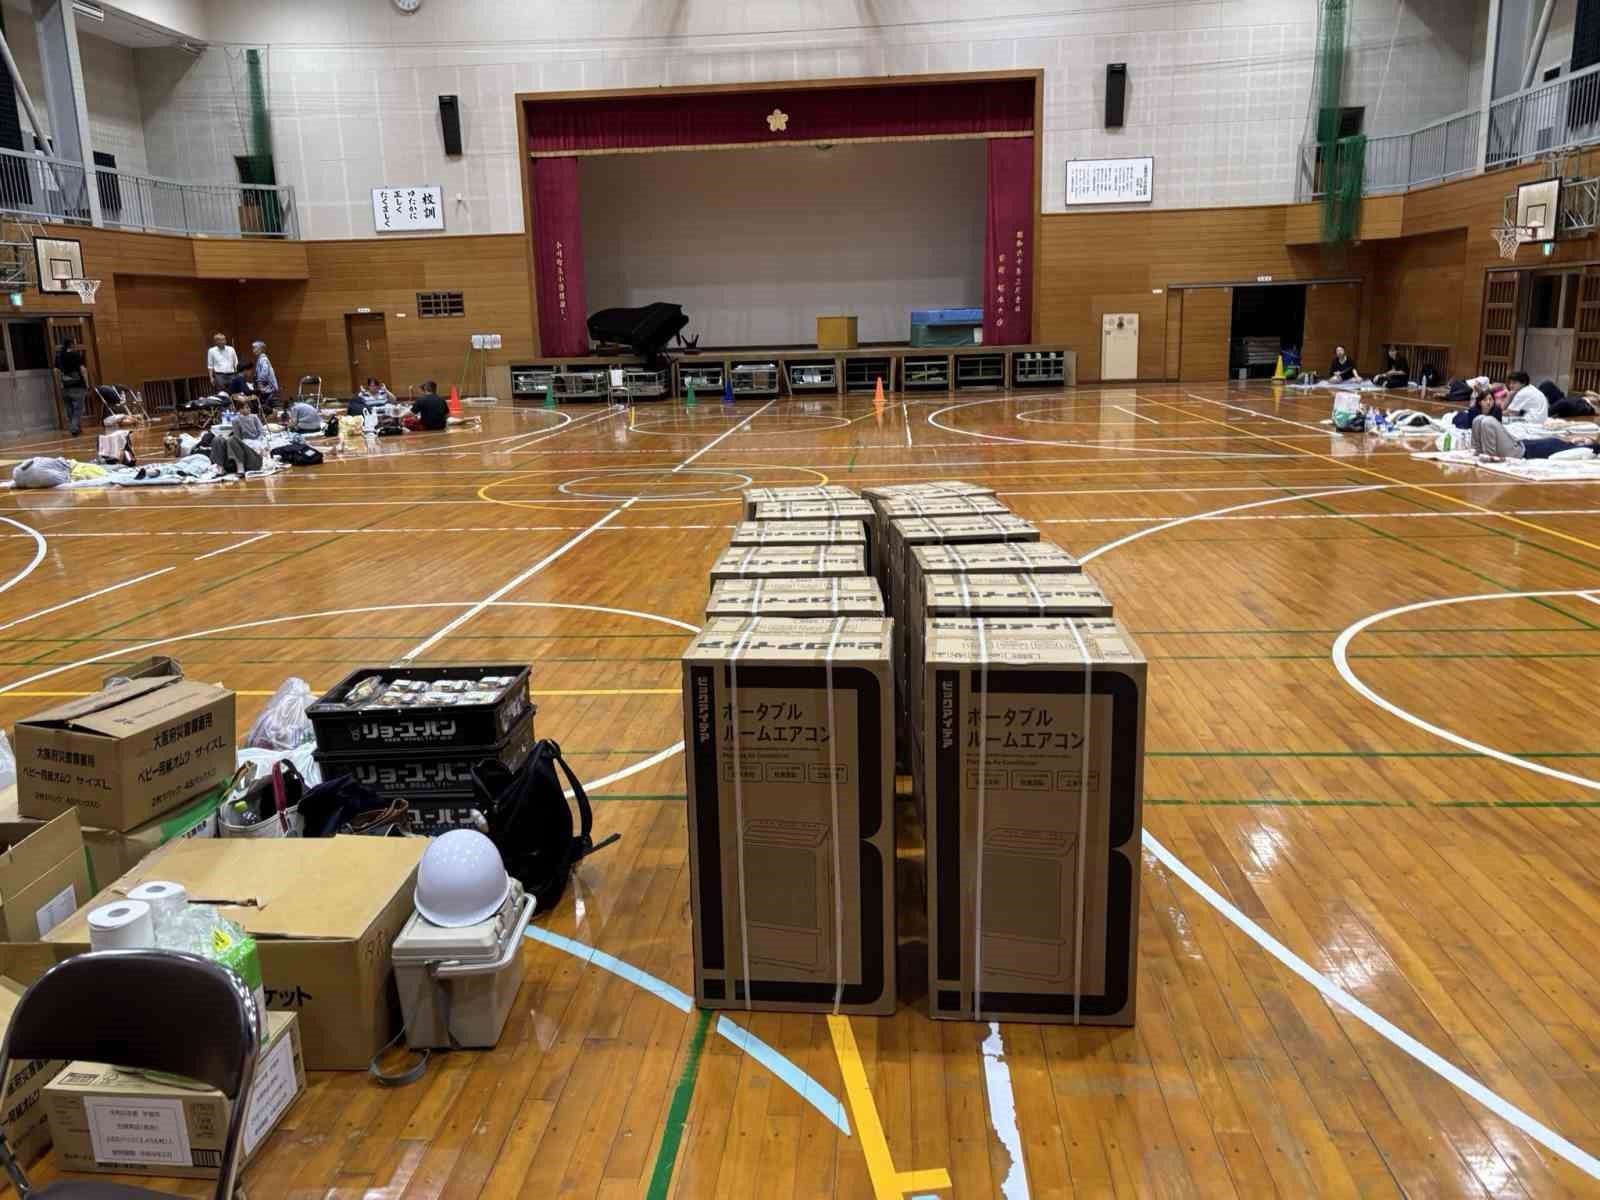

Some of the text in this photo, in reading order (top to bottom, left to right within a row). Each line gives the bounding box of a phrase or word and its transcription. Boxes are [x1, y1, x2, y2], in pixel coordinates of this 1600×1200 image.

[380, 191, 391, 228] たくましく
[393, 190, 403, 214] 正しく
[407, 190, 418, 220] ゆたかに
[422, 193, 437, 219] 校訓
[723, 725, 830, 743] ルームエアコン
[967, 730, 1085, 750] ルームエアコン
